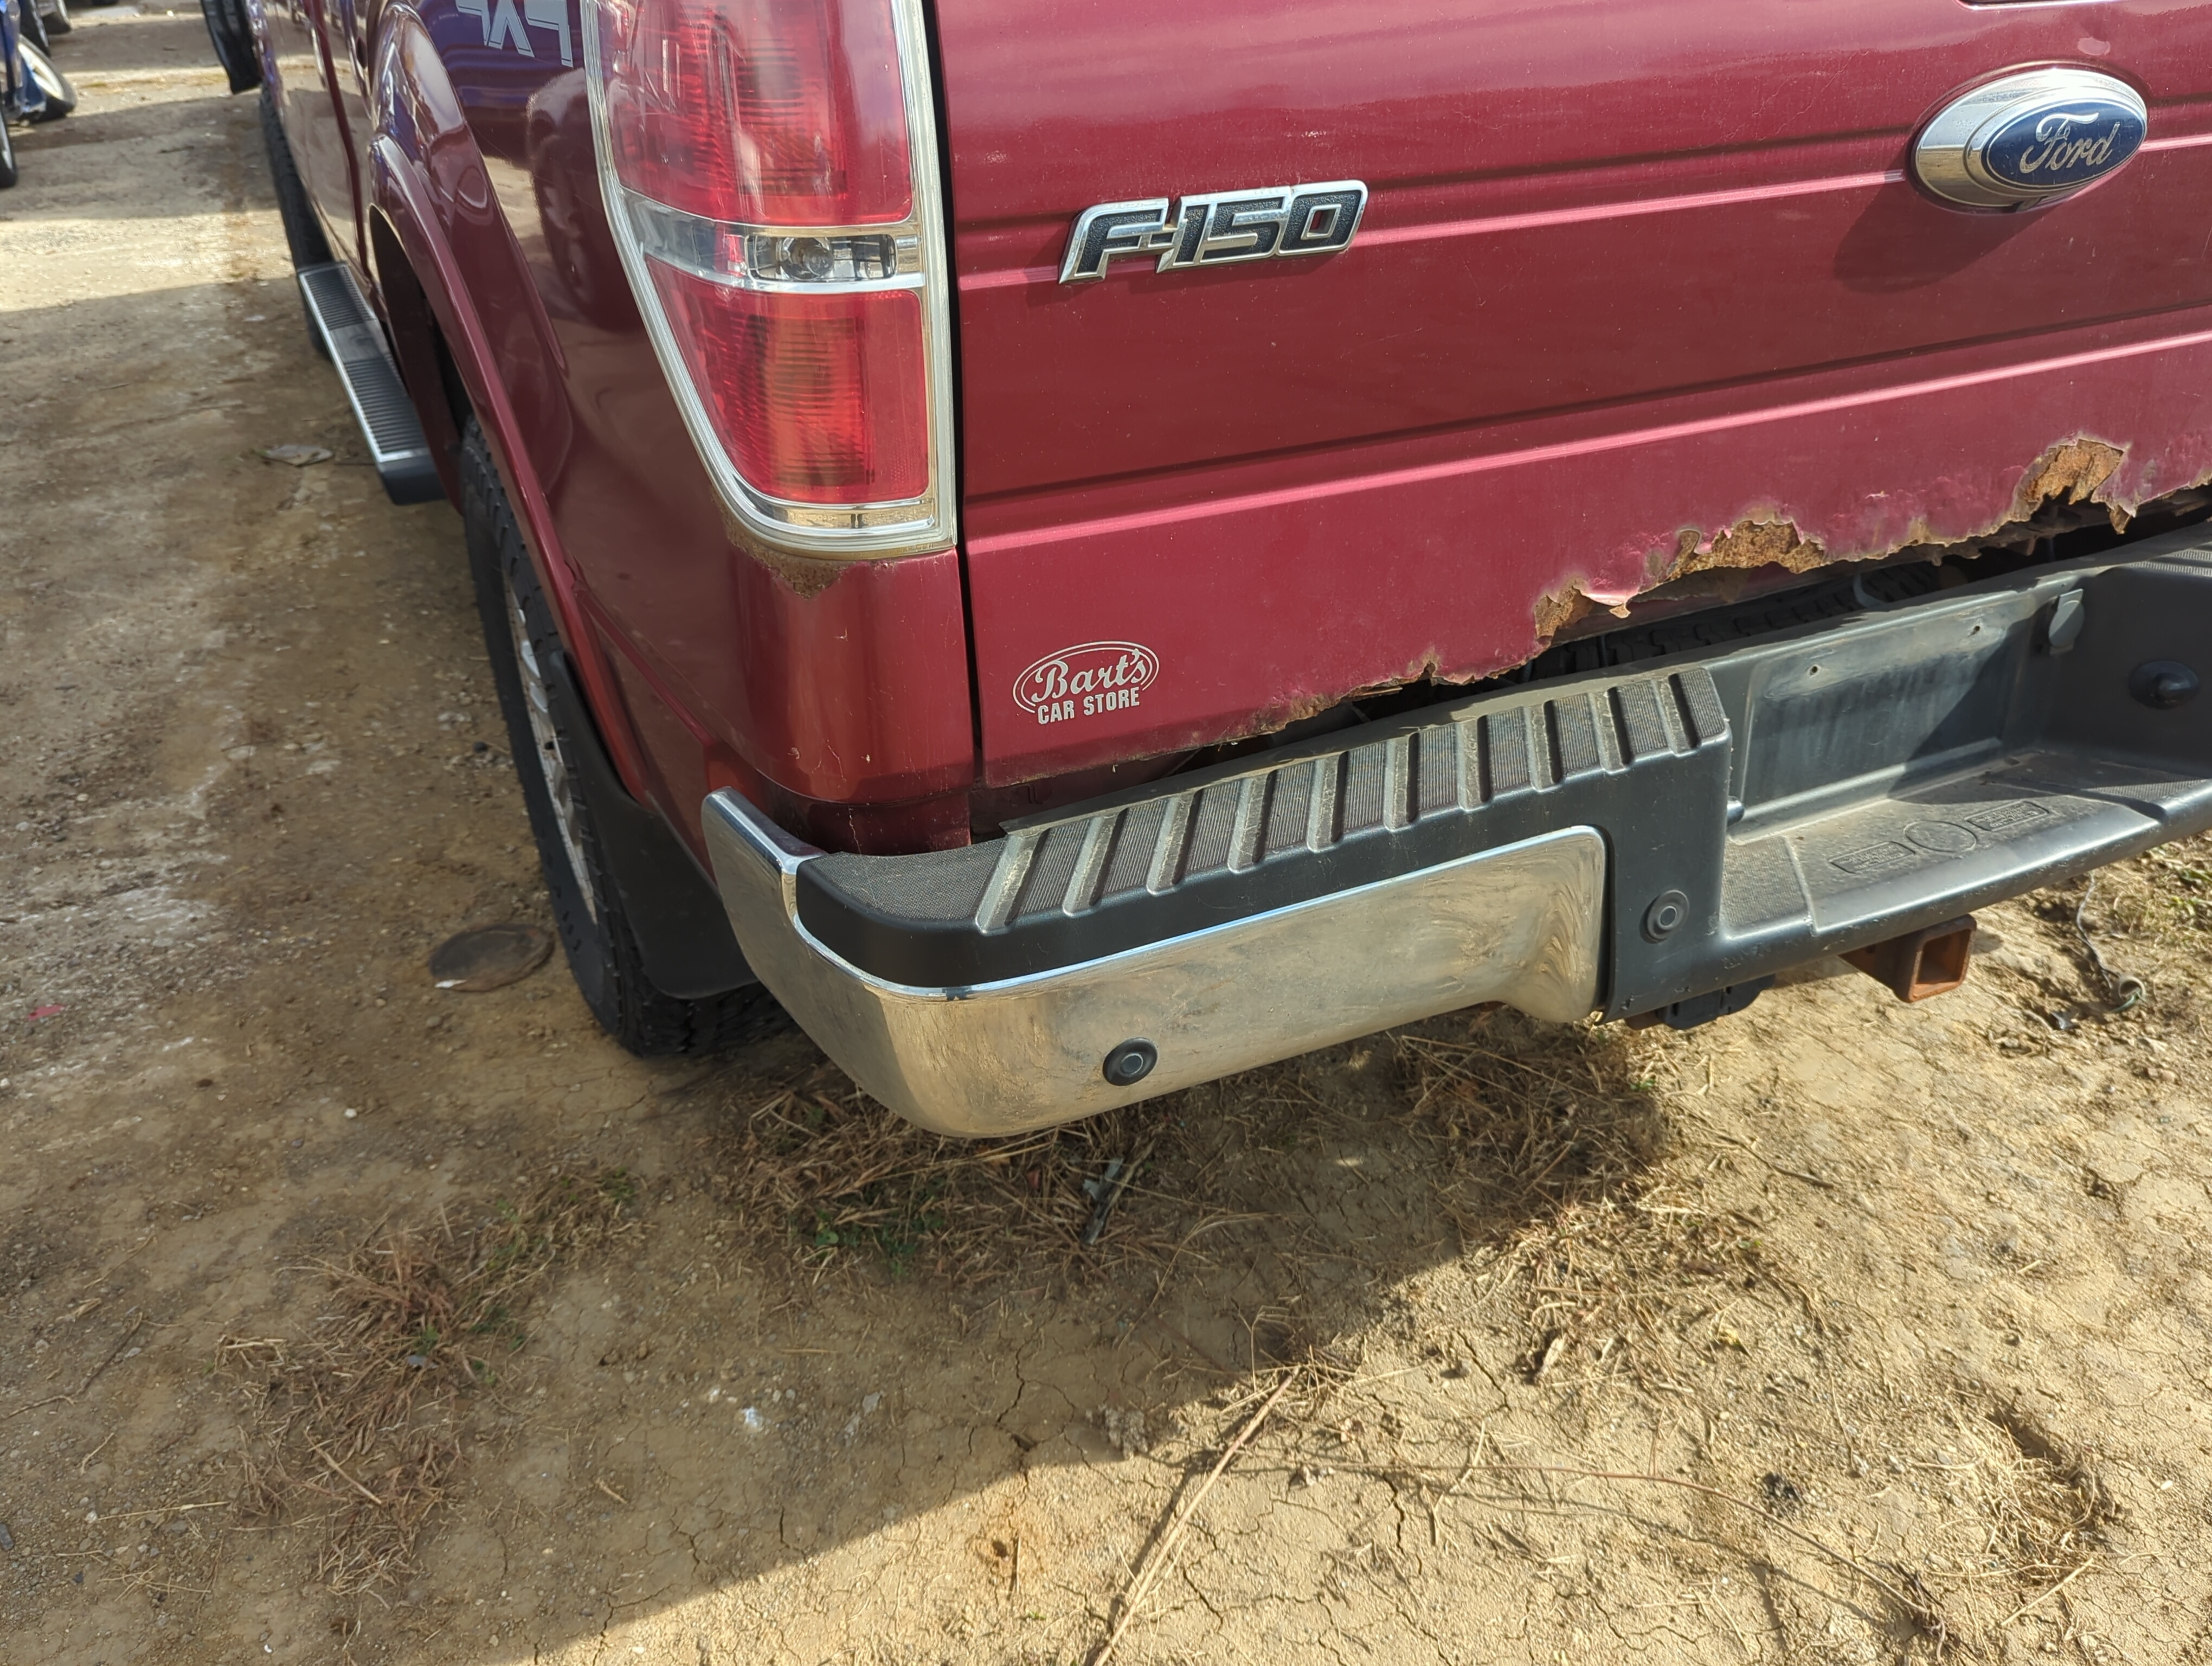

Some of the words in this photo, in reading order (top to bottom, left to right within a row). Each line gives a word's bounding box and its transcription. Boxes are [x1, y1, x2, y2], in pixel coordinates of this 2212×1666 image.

[2019, 112, 2120, 174] Ford
[1059, 180, 1368, 284] F-150
[1031, 648, 1146, 703] Bart's
[1037, 700, 1075, 725] CAR
[1083, 687, 1140, 716] STORE
